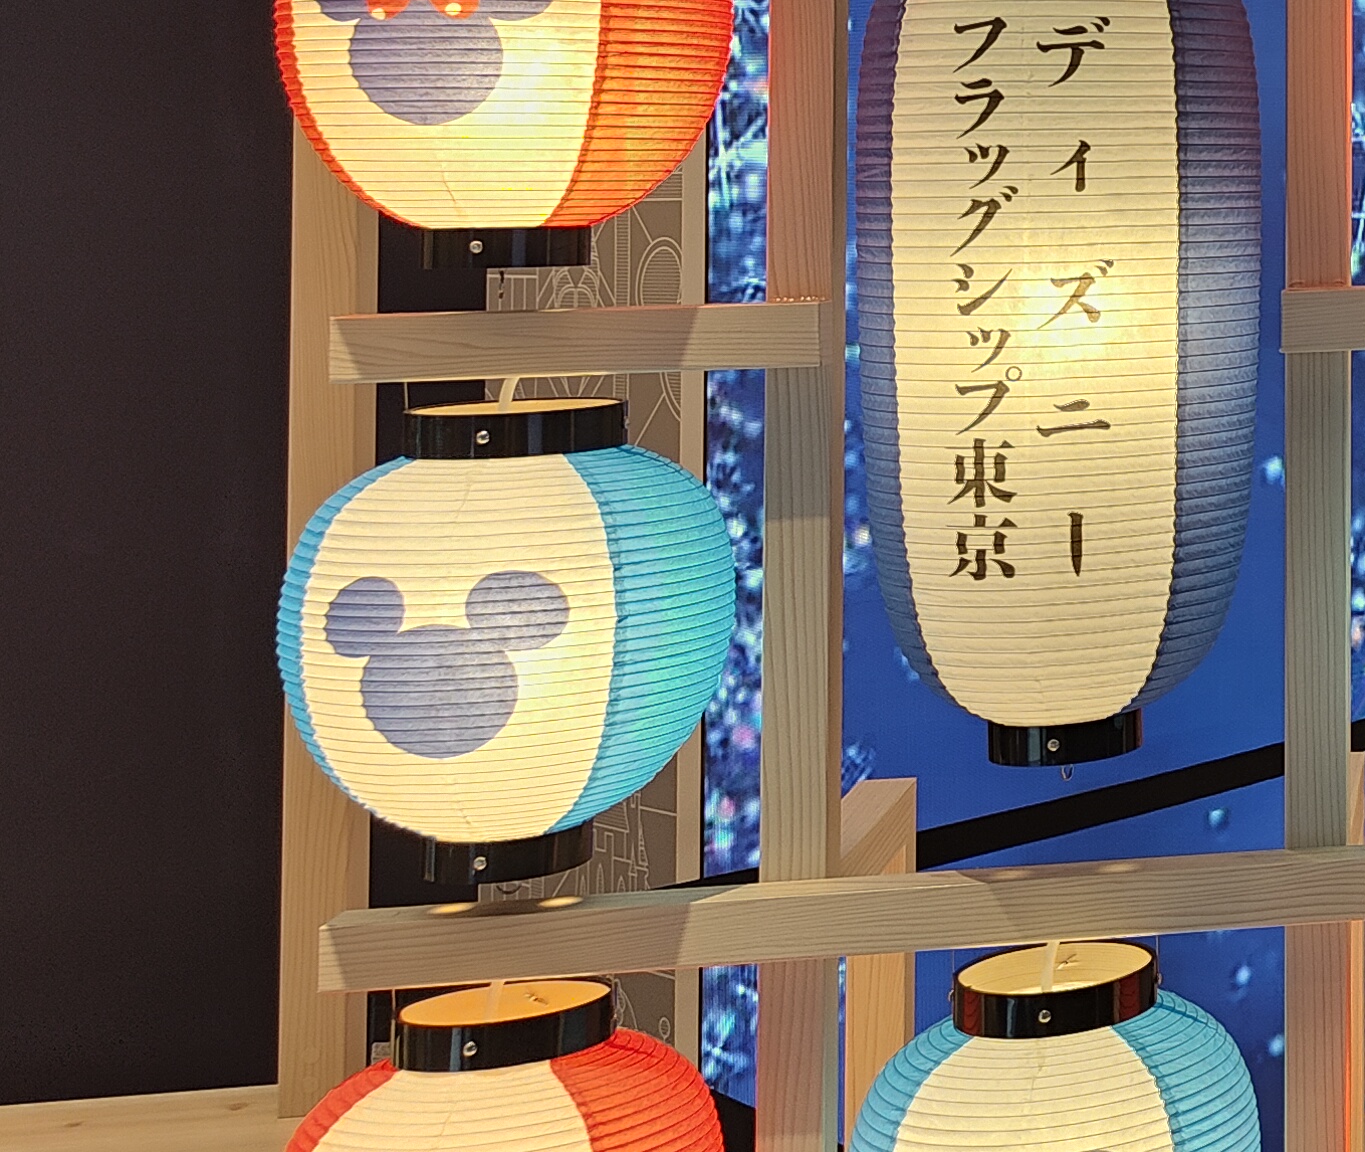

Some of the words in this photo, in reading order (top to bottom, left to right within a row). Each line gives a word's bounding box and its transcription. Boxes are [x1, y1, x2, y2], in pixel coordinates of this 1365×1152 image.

[949, 16, 1019, 580] フラッグシップ東京
[1035, 16, 1114, 577] ディズニー
